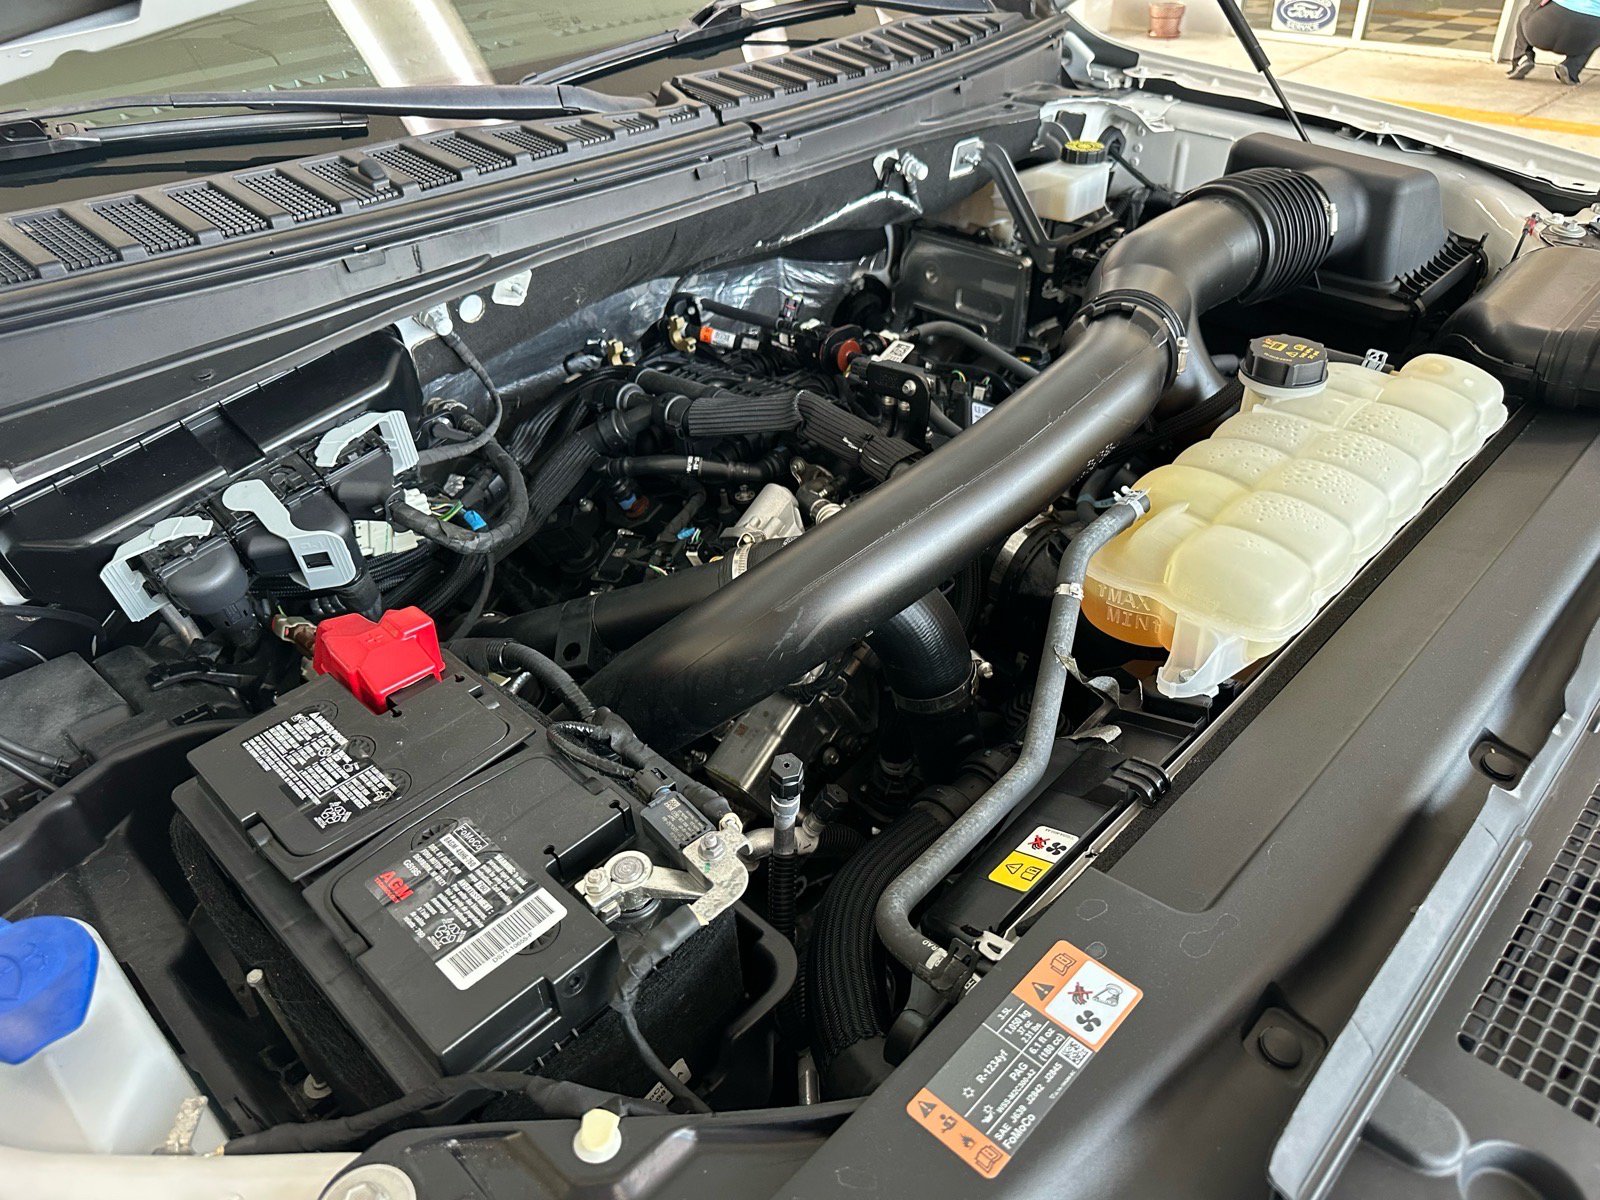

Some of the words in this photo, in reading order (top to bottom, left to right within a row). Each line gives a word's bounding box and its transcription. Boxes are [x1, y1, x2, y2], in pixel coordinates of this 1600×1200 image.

[1287, 2, 1324, 19] Ford
[1107, 606, 1149, 631] MIN
[457, 826, 484, 850] FoMoCo
[380, 868, 414, 900] AGM
[477, 883, 488, 892] 760
[922, 939, 941, 951] RAD
[997, 1006, 1012, 1020] 3.5L
[1004, 1017, 1023, 1035] 1.050
[1018, 1009, 1032, 1021] kg
[1016, 1026, 1026, 1035] 37
[1024, 1020, 1033, 1029] oz
[1021, 1030, 1034, 1043] 2.31
[1030, 1022, 1042, 1032] lbs
[1029, 1042, 1042, 1055] 6.1
[1038, 1036, 1047, 1044] fl
[1044, 1027, 1055, 1038] oz
[1038, 1044, 1056, 1062] (180
[1051, 1033, 1066, 1047] cc)
[975, 1049, 1010, 1085] R-1234yf
[1009, 1061, 1029, 1081] PAG
[994, 1122, 1012, 1141] SAE
[1009, 1104, 1028, 1124] J639
[1024, 1083, 1045, 1105] J2842
[1043, 1062, 1063, 1083] J2845
[1002, 1112, 1037, 1150] FoMoCo
